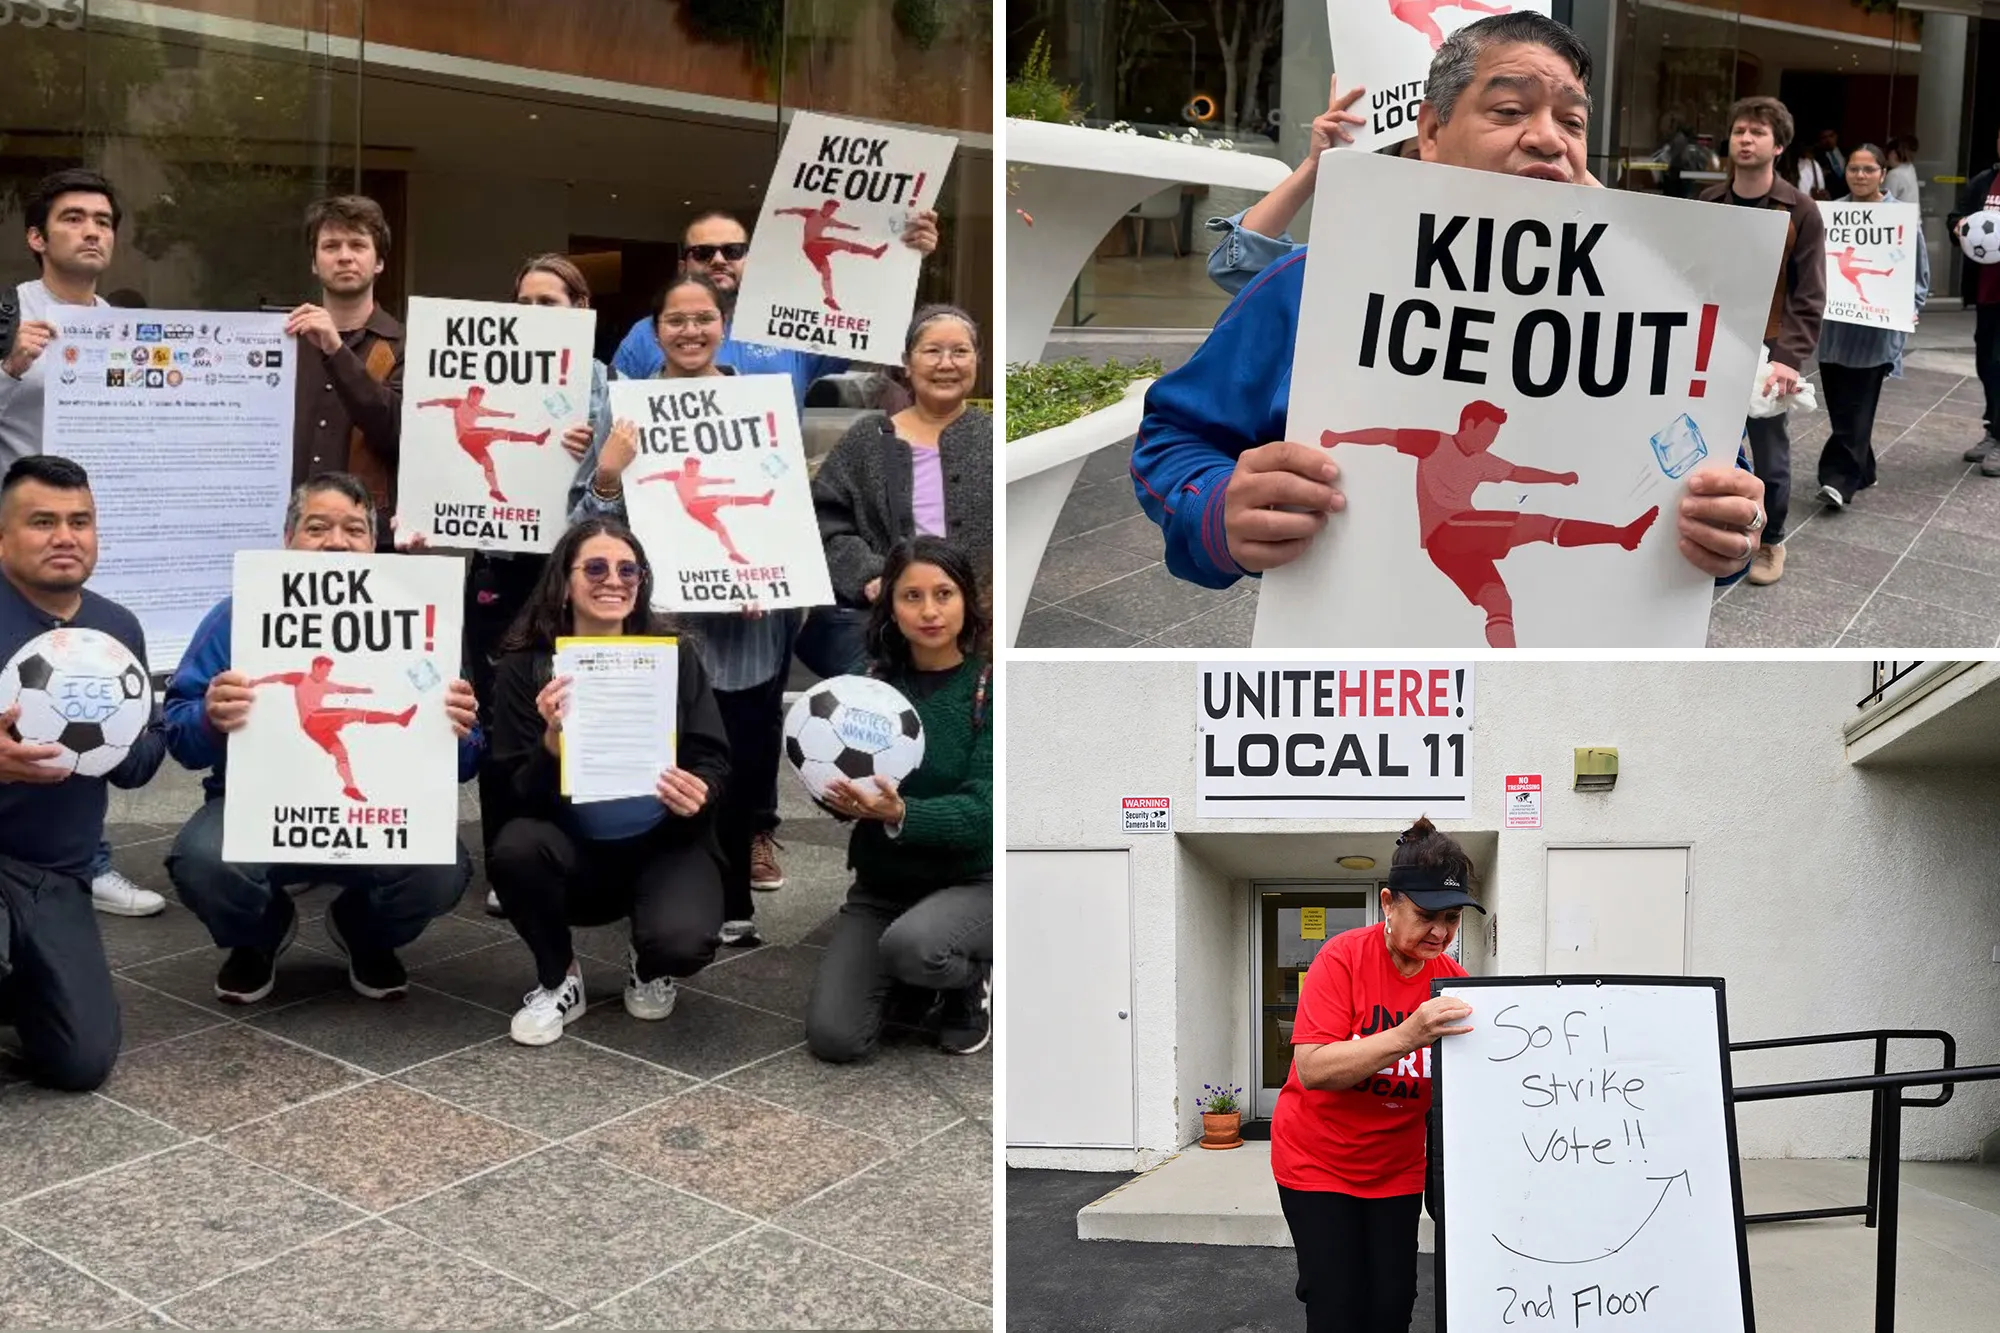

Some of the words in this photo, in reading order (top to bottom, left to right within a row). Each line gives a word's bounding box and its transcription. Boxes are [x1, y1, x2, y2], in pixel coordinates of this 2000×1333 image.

[1373, 99, 1422, 135] LOC
[818, 135, 890, 167] KICK
[793, 164, 842, 195] ICE
[844, 171, 926, 207] OUT!
[1833, 210, 1873, 225] KICK
[1855, 224, 1903, 245] OUT!
[1414, 213, 1608, 297] KICK
[1828, 308, 1872, 320] LOCAL
[1879, 315, 1890, 323] 11
[1829, 301, 1857, 309] UNITE
[771, 304, 819, 324] UNITE
[824, 313, 870, 332] HERE!
[446, 317, 518, 347] KICK
[768, 319, 837, 345] LOCAL
[850, 333, 868, 350] 11
[1358, 293, 1495, 386] ICE
[1510, 304, 1720, 399] OUT!
[429, 349, 477, 381] ICE
[485, 349, 570, 386] OUT!
[648, 389, 723, 423] KICK
[639, 426, 689, 454] ICE
[694, 411, 778, 454] OUT!
[435, 503, 486, 519] UNITE
[493, 507, 540, 522] HERE!
[434, 518, 508, 539] LOCAL
[520, 525, 540, 541] 11
[679, 569, 731, 583] UNITE
[736, 566, 786, 580] HERE!
[282, 569, 373, 607] KICK
[681, 584, 758, 600] LOCAL
[769, 581, 791, 598] 11
[262, 612, 323, 649] ICE
[332, 605, 436, 652] OUT!
[61, 682, 113, 699] ICE
[65, 702, 117, 719] OUT
[1205, 733, 1409, 777] LOCAL
[1422, 733, 1464, 777] 11
[274, 807, 340, 825] UNITE
[348, 807, 407, 825] HERE!
[1125, 799, 1168, 808] WARNING
[1125, 811, 1149, 820] Security
[1125, 820, 1149, 828] Cameras
[272, 826, 368, 849] LOCAL
[383, 828, 408, 849] 11
[1361, 1004, 1412, 1035] UN
[1352, 1076, 1419, 1099] OCAL
[1497, 1284, 1555, 1325] 2nd
[1572, 1284, 1660, 1328] Floor
